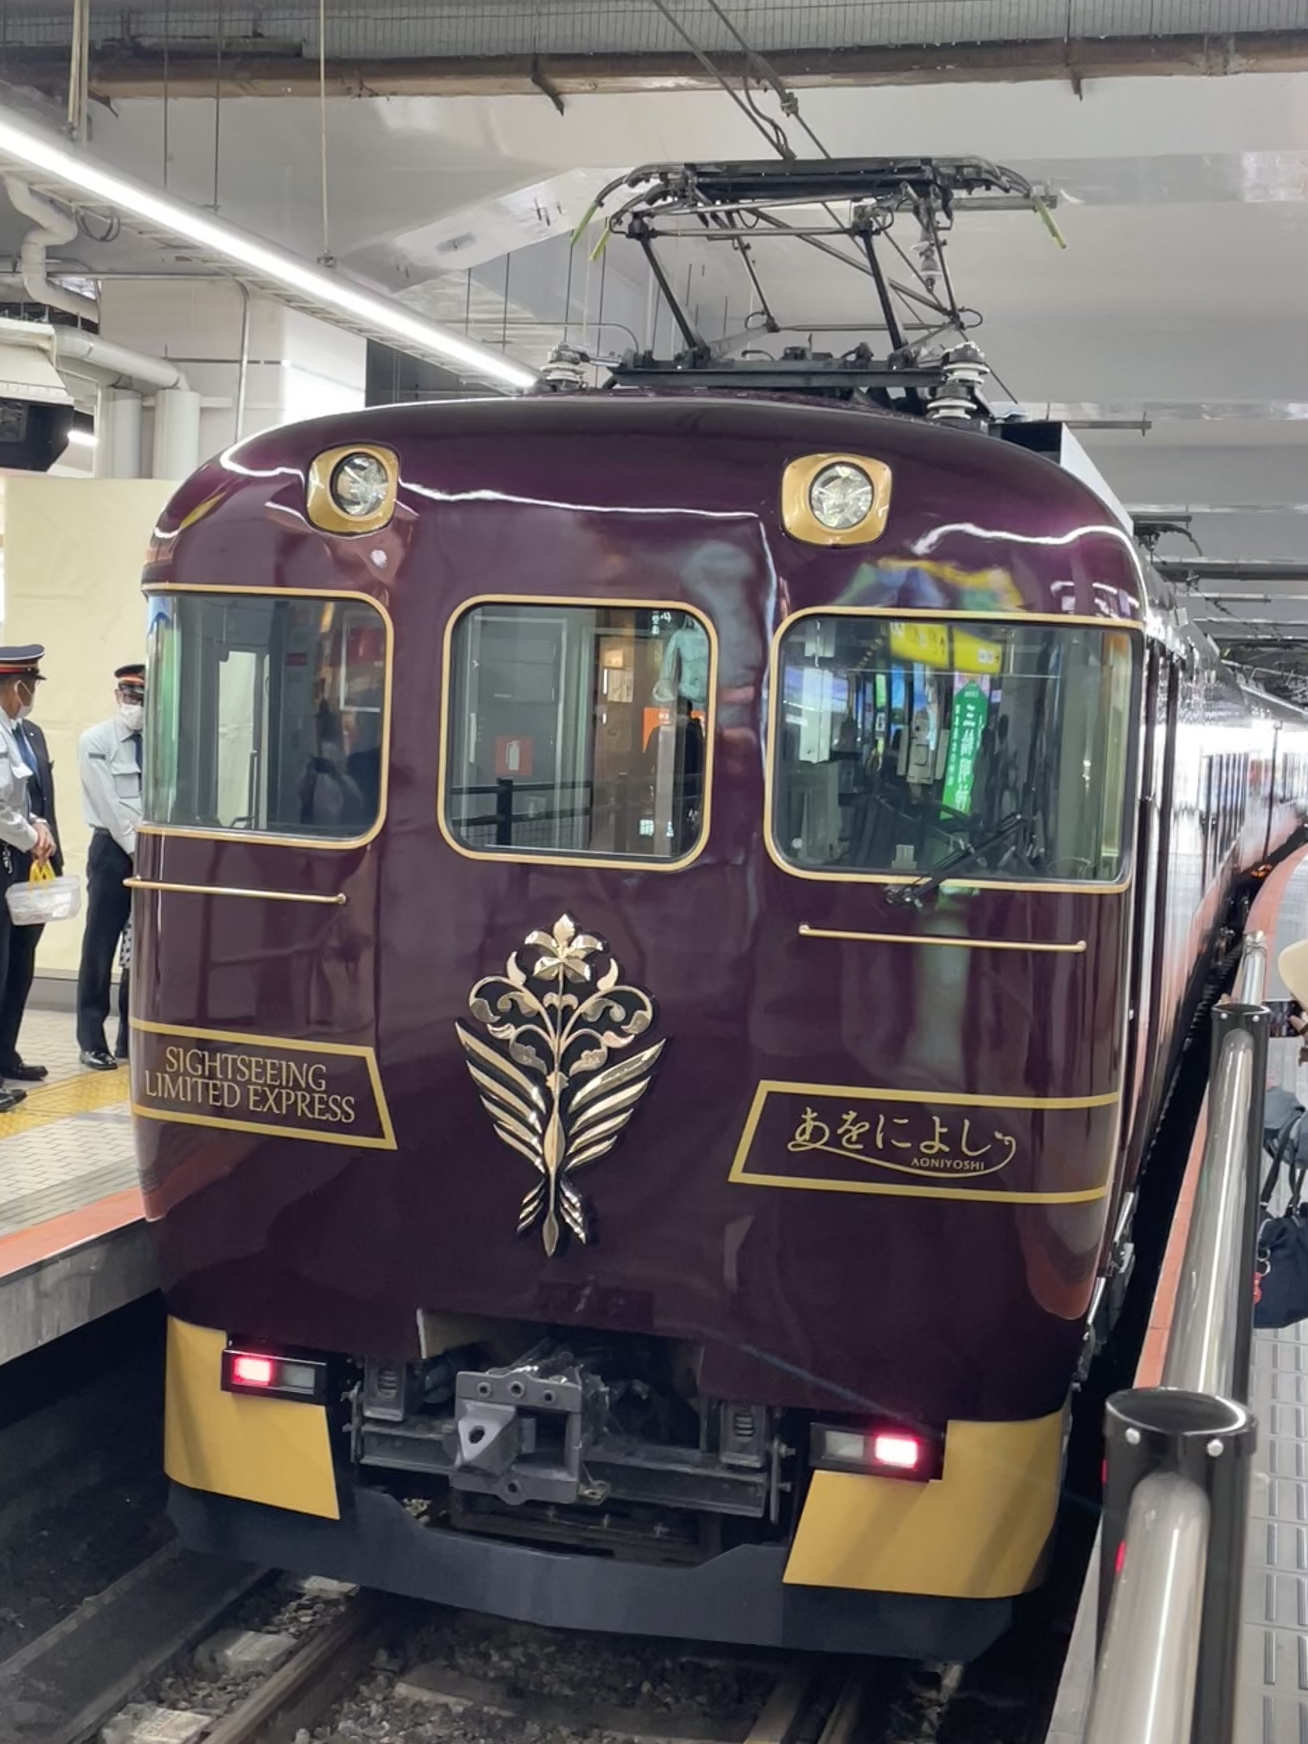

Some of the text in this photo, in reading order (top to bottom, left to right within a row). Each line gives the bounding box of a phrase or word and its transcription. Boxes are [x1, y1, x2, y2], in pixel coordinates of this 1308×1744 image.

[165, 1046, 327, 1092] SIGHTSEEING
[145, 1070, 355, 1123] LIMITED EXPRESS
[787, 1107, 994, 1158] あをによし
[911, 1156, 985, 1171] AONIYOSHI
